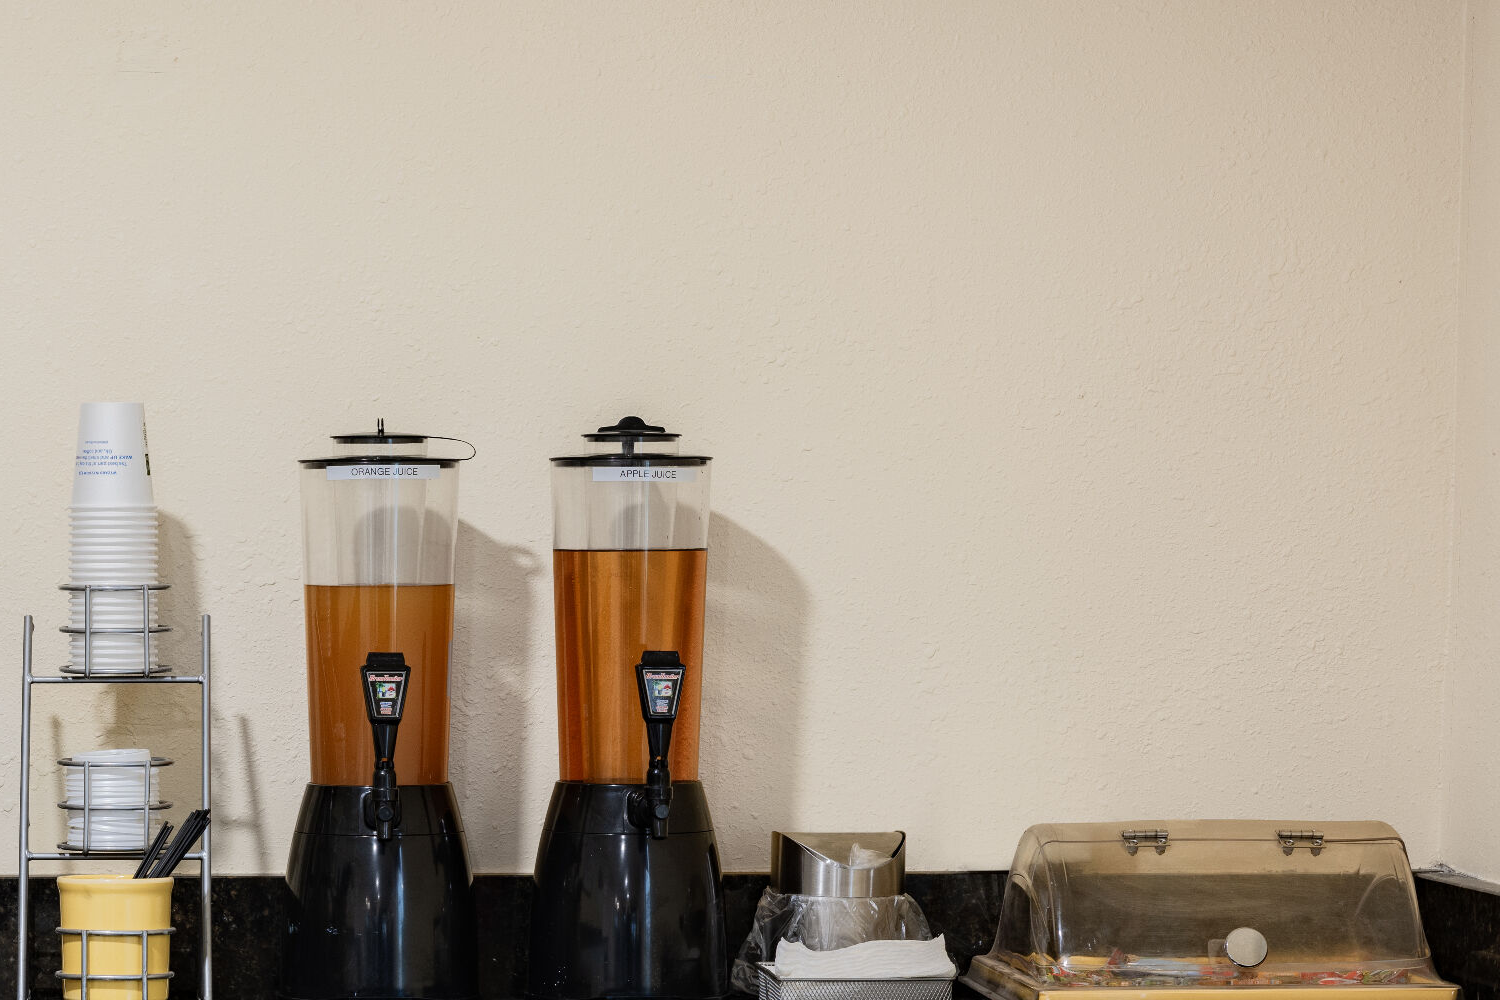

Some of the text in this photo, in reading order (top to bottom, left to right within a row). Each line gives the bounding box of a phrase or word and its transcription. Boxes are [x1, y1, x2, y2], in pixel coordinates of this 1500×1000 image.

[350, 467, 418, 476] ORANGE JUICE
[620, 470, 677, 479] APPLE JUICE
